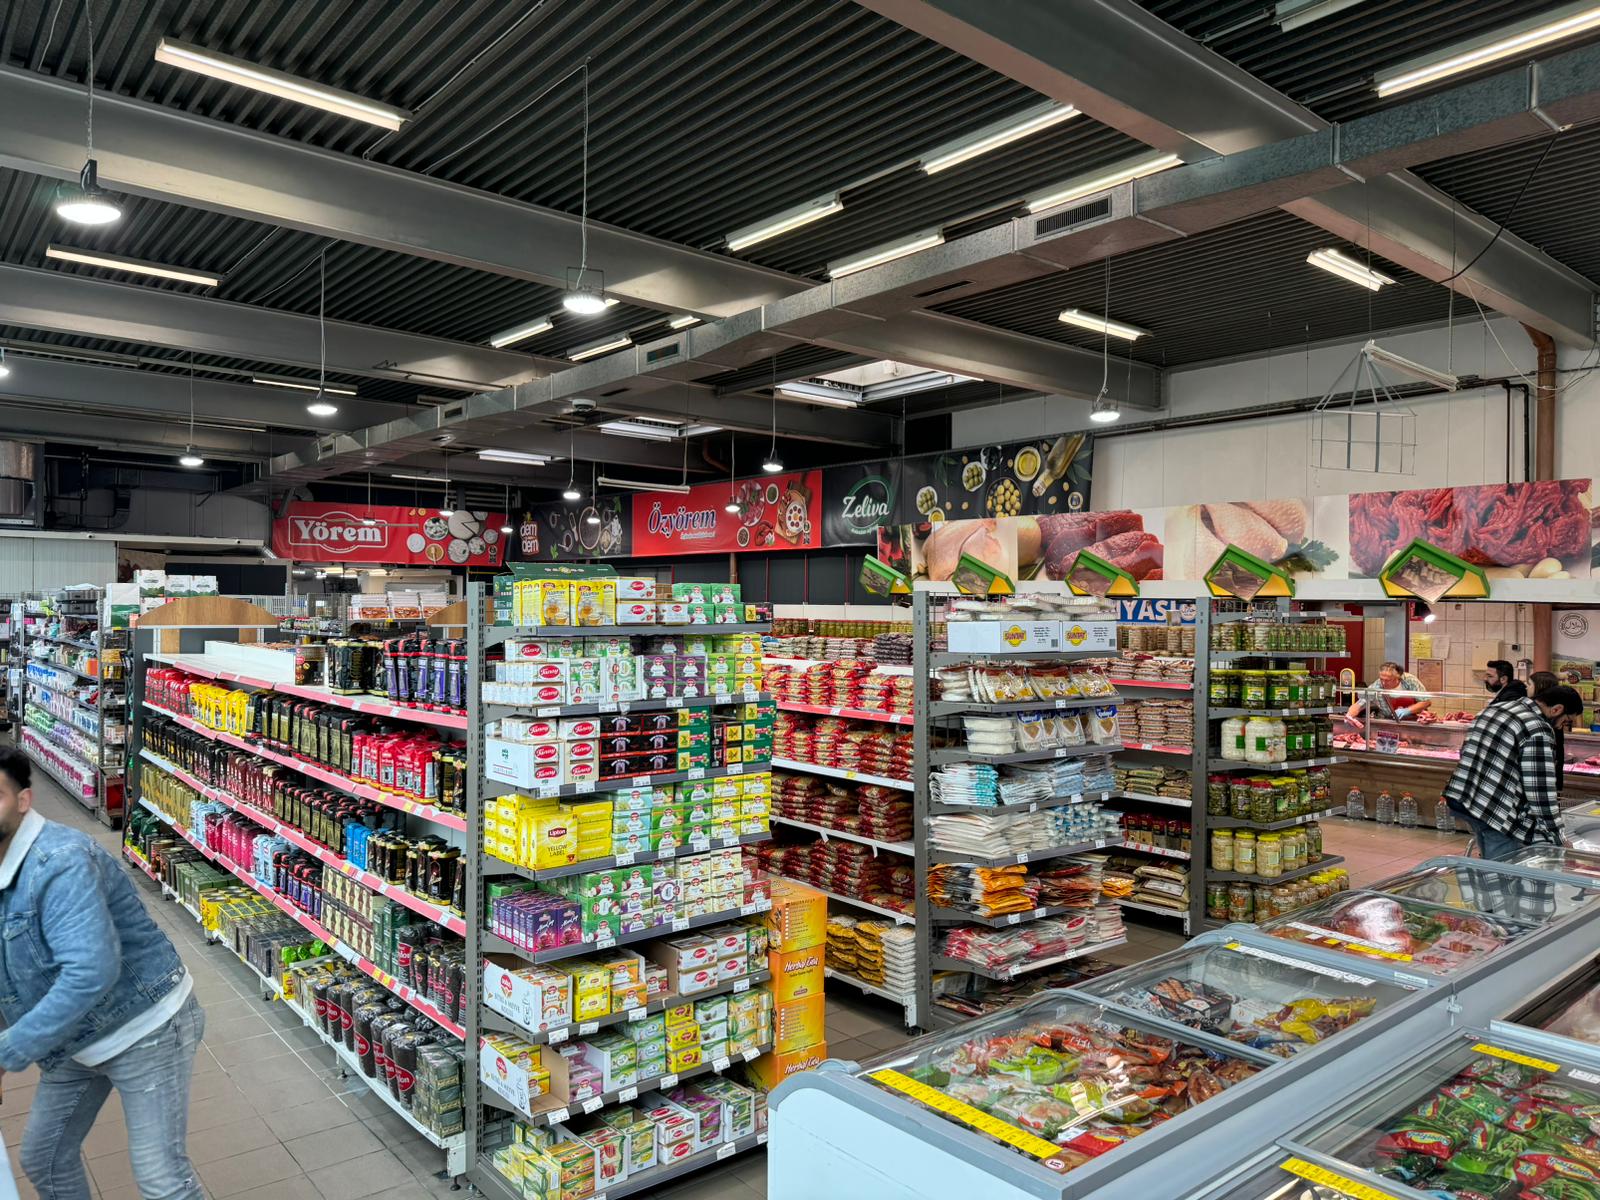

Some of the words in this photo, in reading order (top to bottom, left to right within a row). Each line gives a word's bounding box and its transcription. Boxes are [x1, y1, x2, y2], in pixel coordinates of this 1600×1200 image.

[842, 494, 890, 518] Zeliva
[648, 501, 716, 538] Özyörem
[295, 520, 382, 542] Yörem
[520, 521, 537, 536] dem
[521, 537, 539, 553] dem
[1004, 631, 1026, 641] SUNTAT
[1067, 632, 1088, 641] SUNTAT
[547, 844, 568, 852] YELLOW
[784, 959, 806, 973] Herbal
